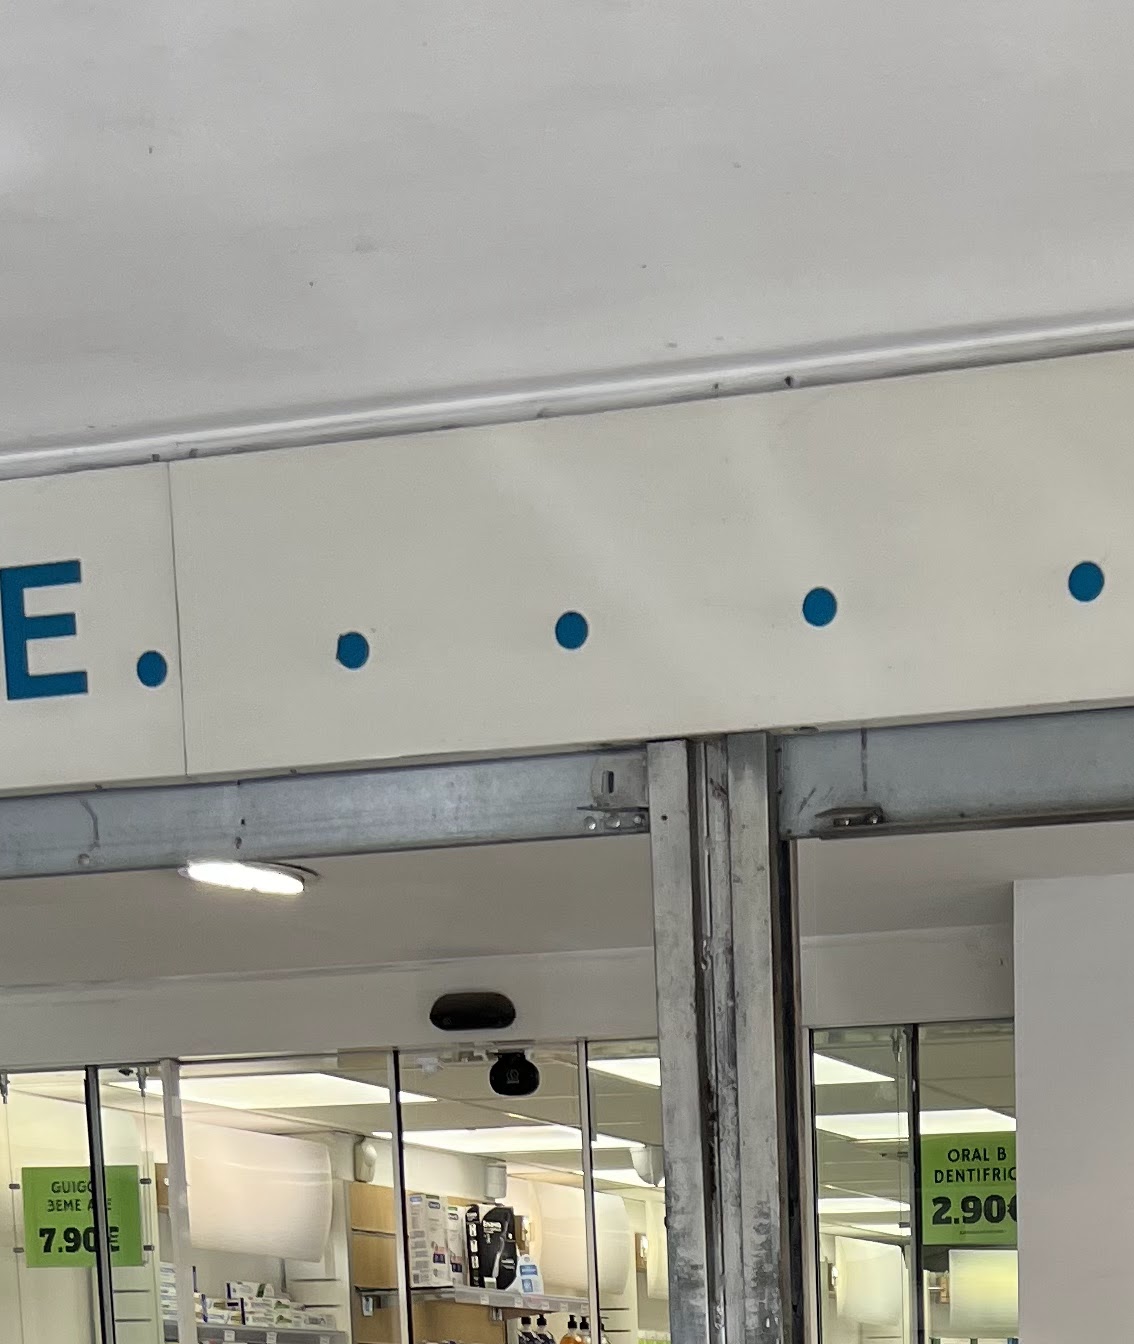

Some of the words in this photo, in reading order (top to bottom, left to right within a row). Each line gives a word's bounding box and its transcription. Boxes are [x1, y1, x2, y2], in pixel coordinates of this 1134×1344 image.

[947, 1148, 989, 1162] ORAL
[997, 1146, 1007, 1161] B
[47, 1199, 82, 1212] 3EME
